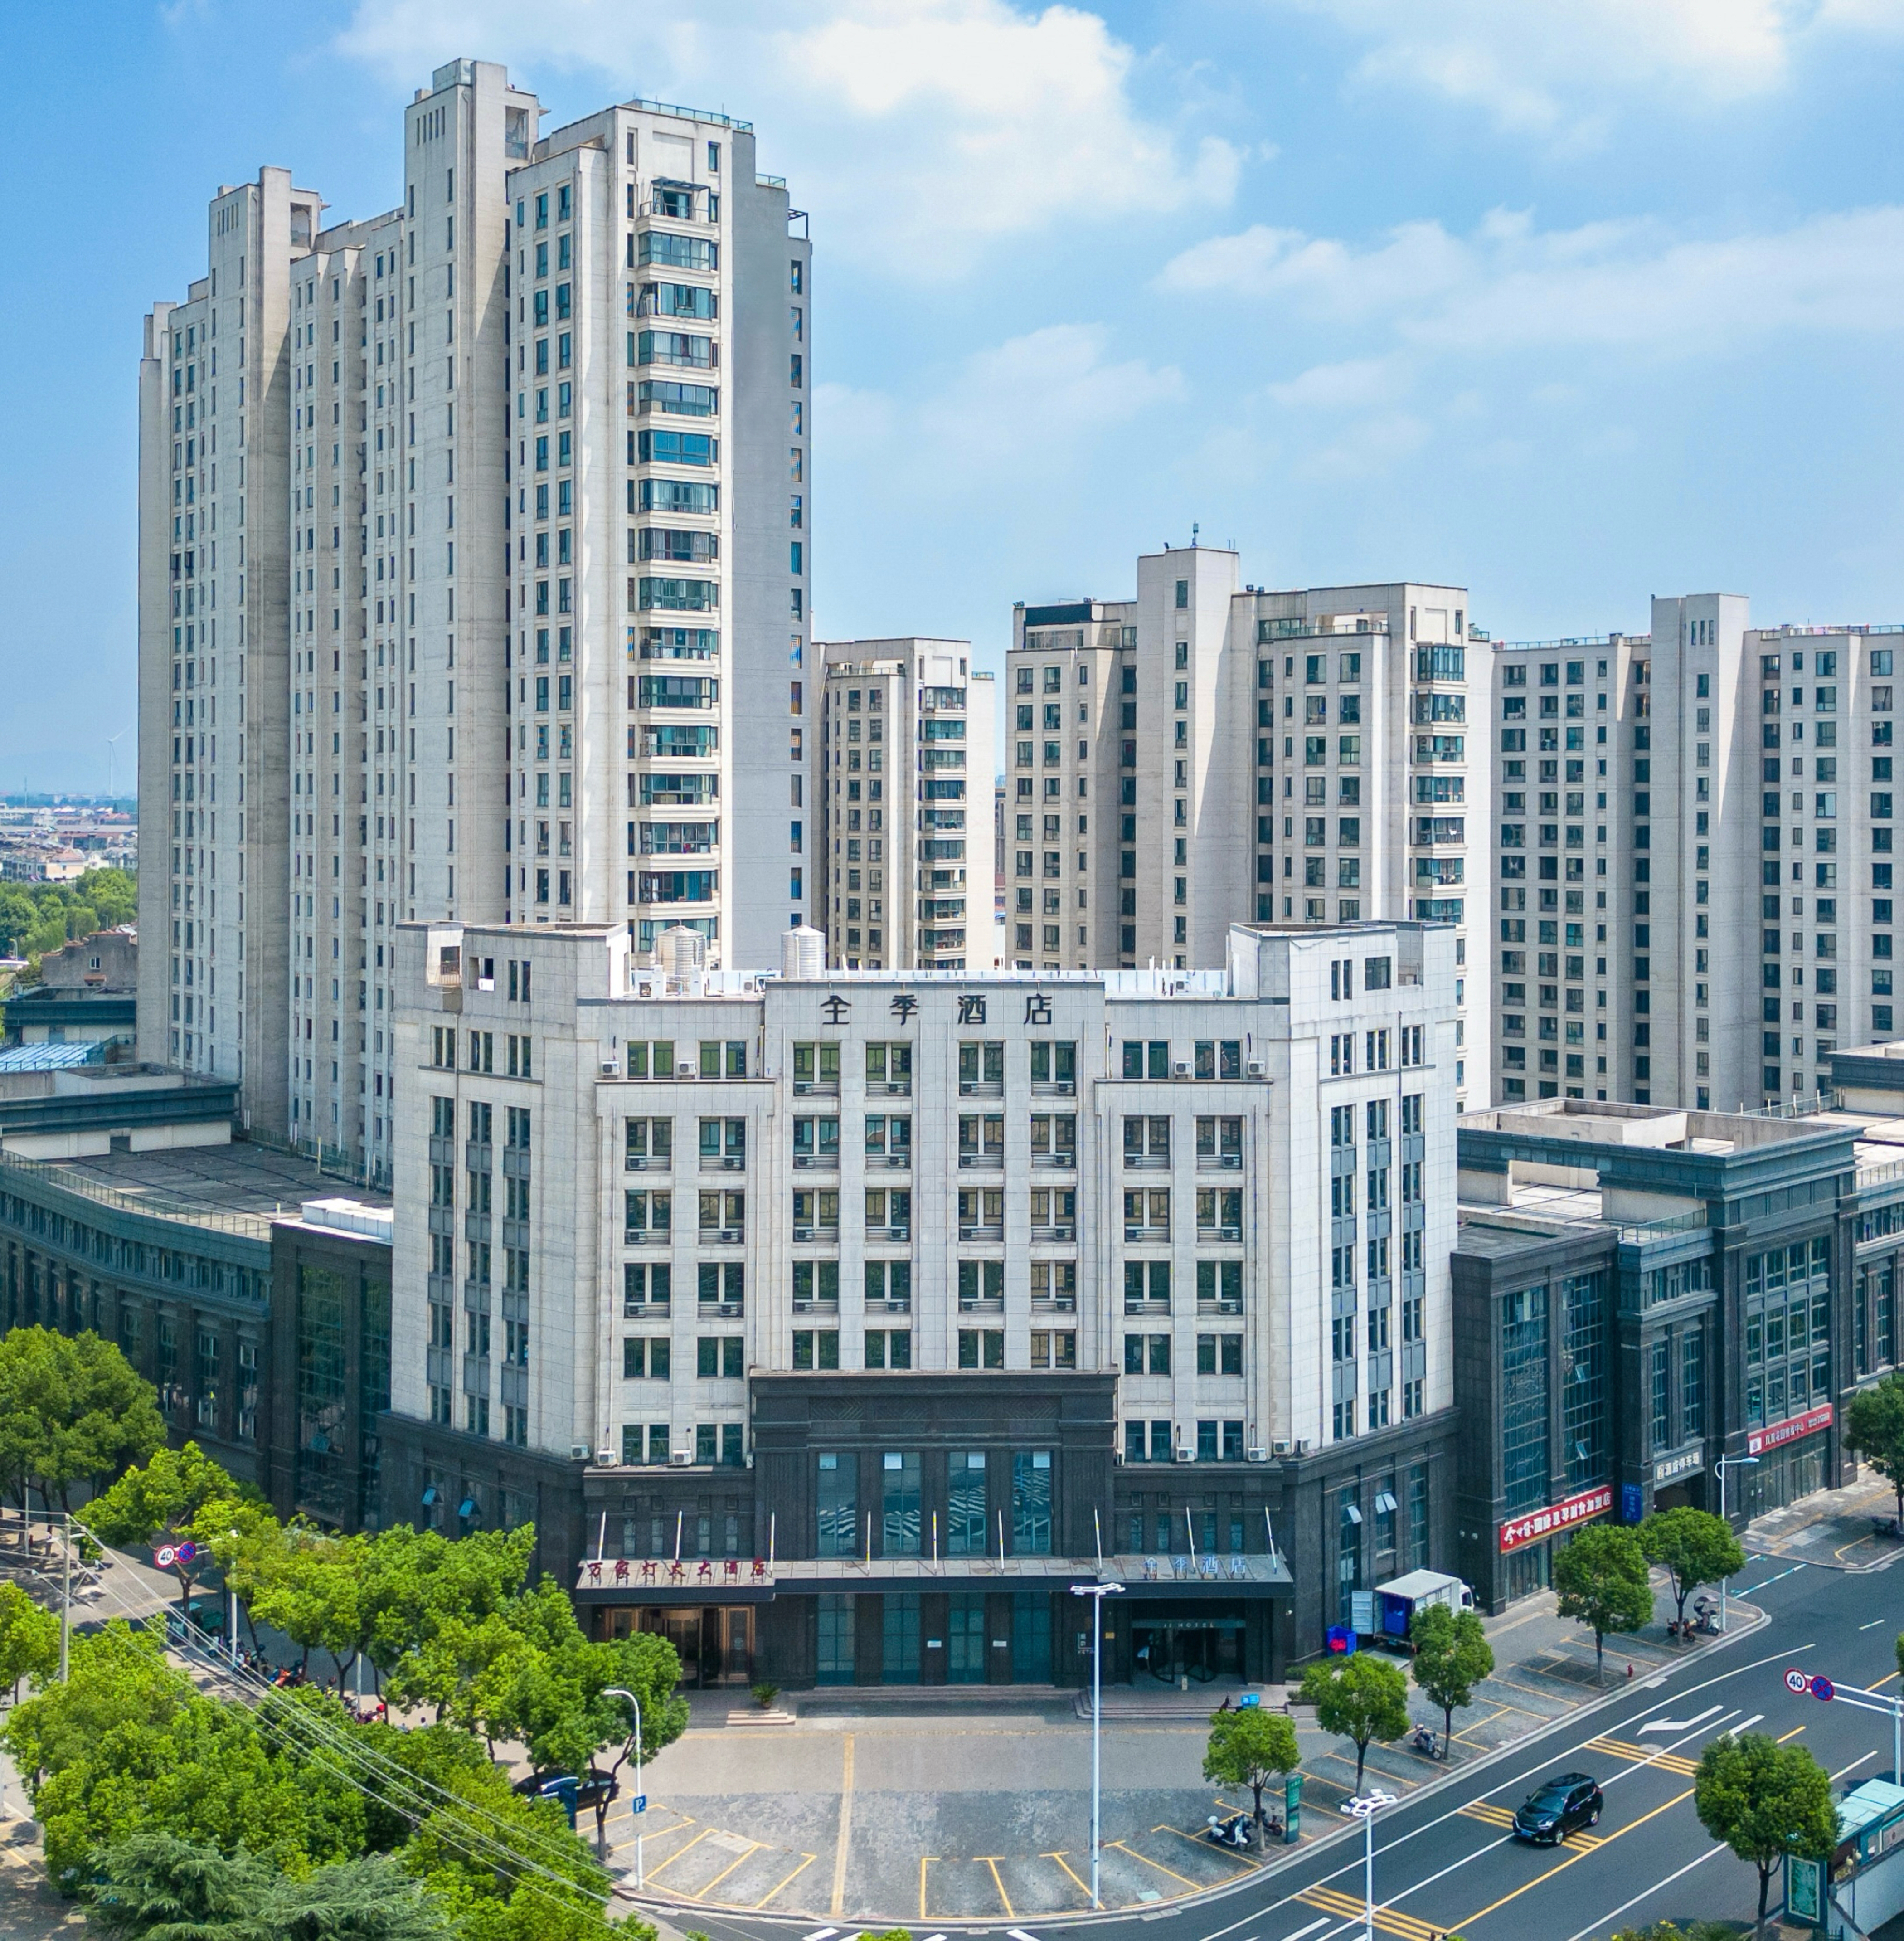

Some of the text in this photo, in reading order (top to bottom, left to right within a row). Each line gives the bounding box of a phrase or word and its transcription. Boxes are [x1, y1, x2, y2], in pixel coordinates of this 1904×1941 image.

[820, 994, 1053, 1026] 全季酒店
[160, 1551, 173, 1562] 40
[588, 1557, 765, 1579] 万家灯火大酒店
[1144, 1556, 1246, 1574] 全季酒店
[1789, 1675, 1803, 1688] 40
[635, 1798, 643, 1812] P
